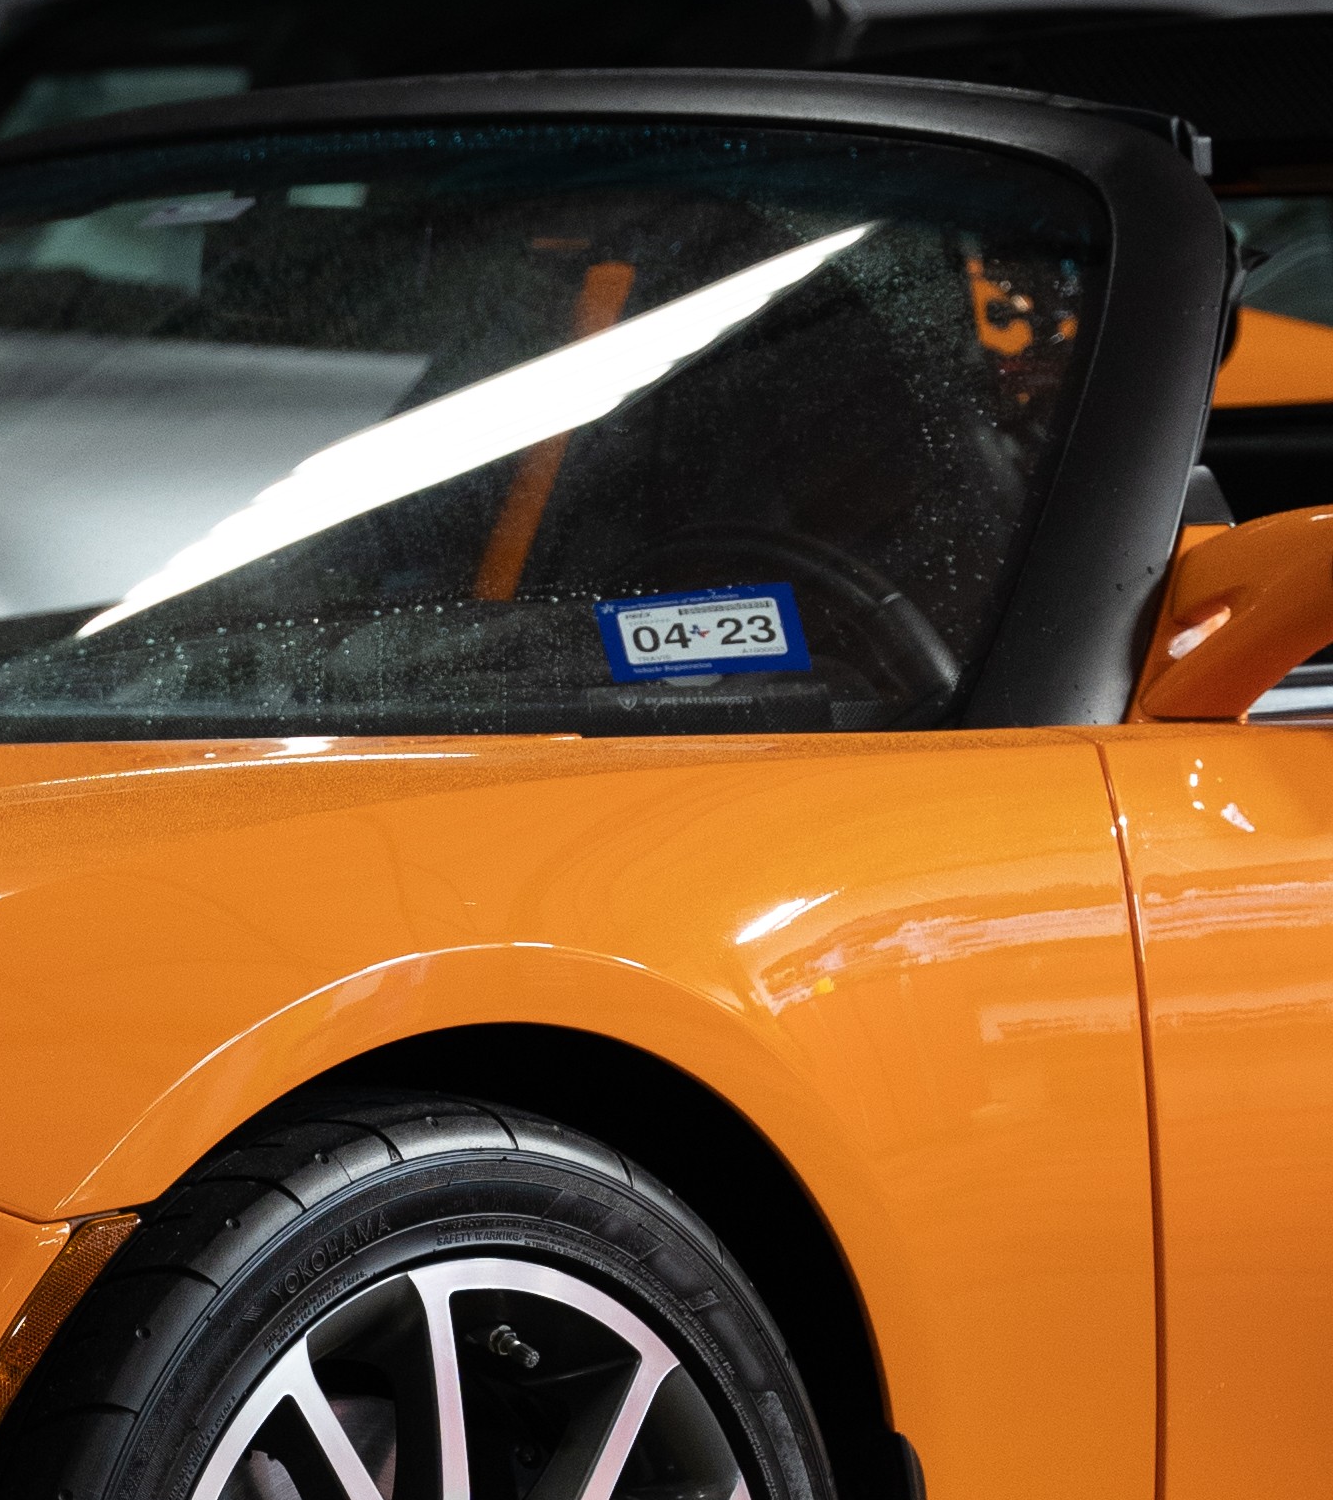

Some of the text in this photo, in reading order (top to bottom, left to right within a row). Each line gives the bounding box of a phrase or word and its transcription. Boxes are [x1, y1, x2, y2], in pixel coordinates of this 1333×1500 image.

[632, 615, 777, 653] 04 23
[436, 1231, 471, 1246] SAFETY
[271, 1212, 392, 1306] YOKOHAMA
